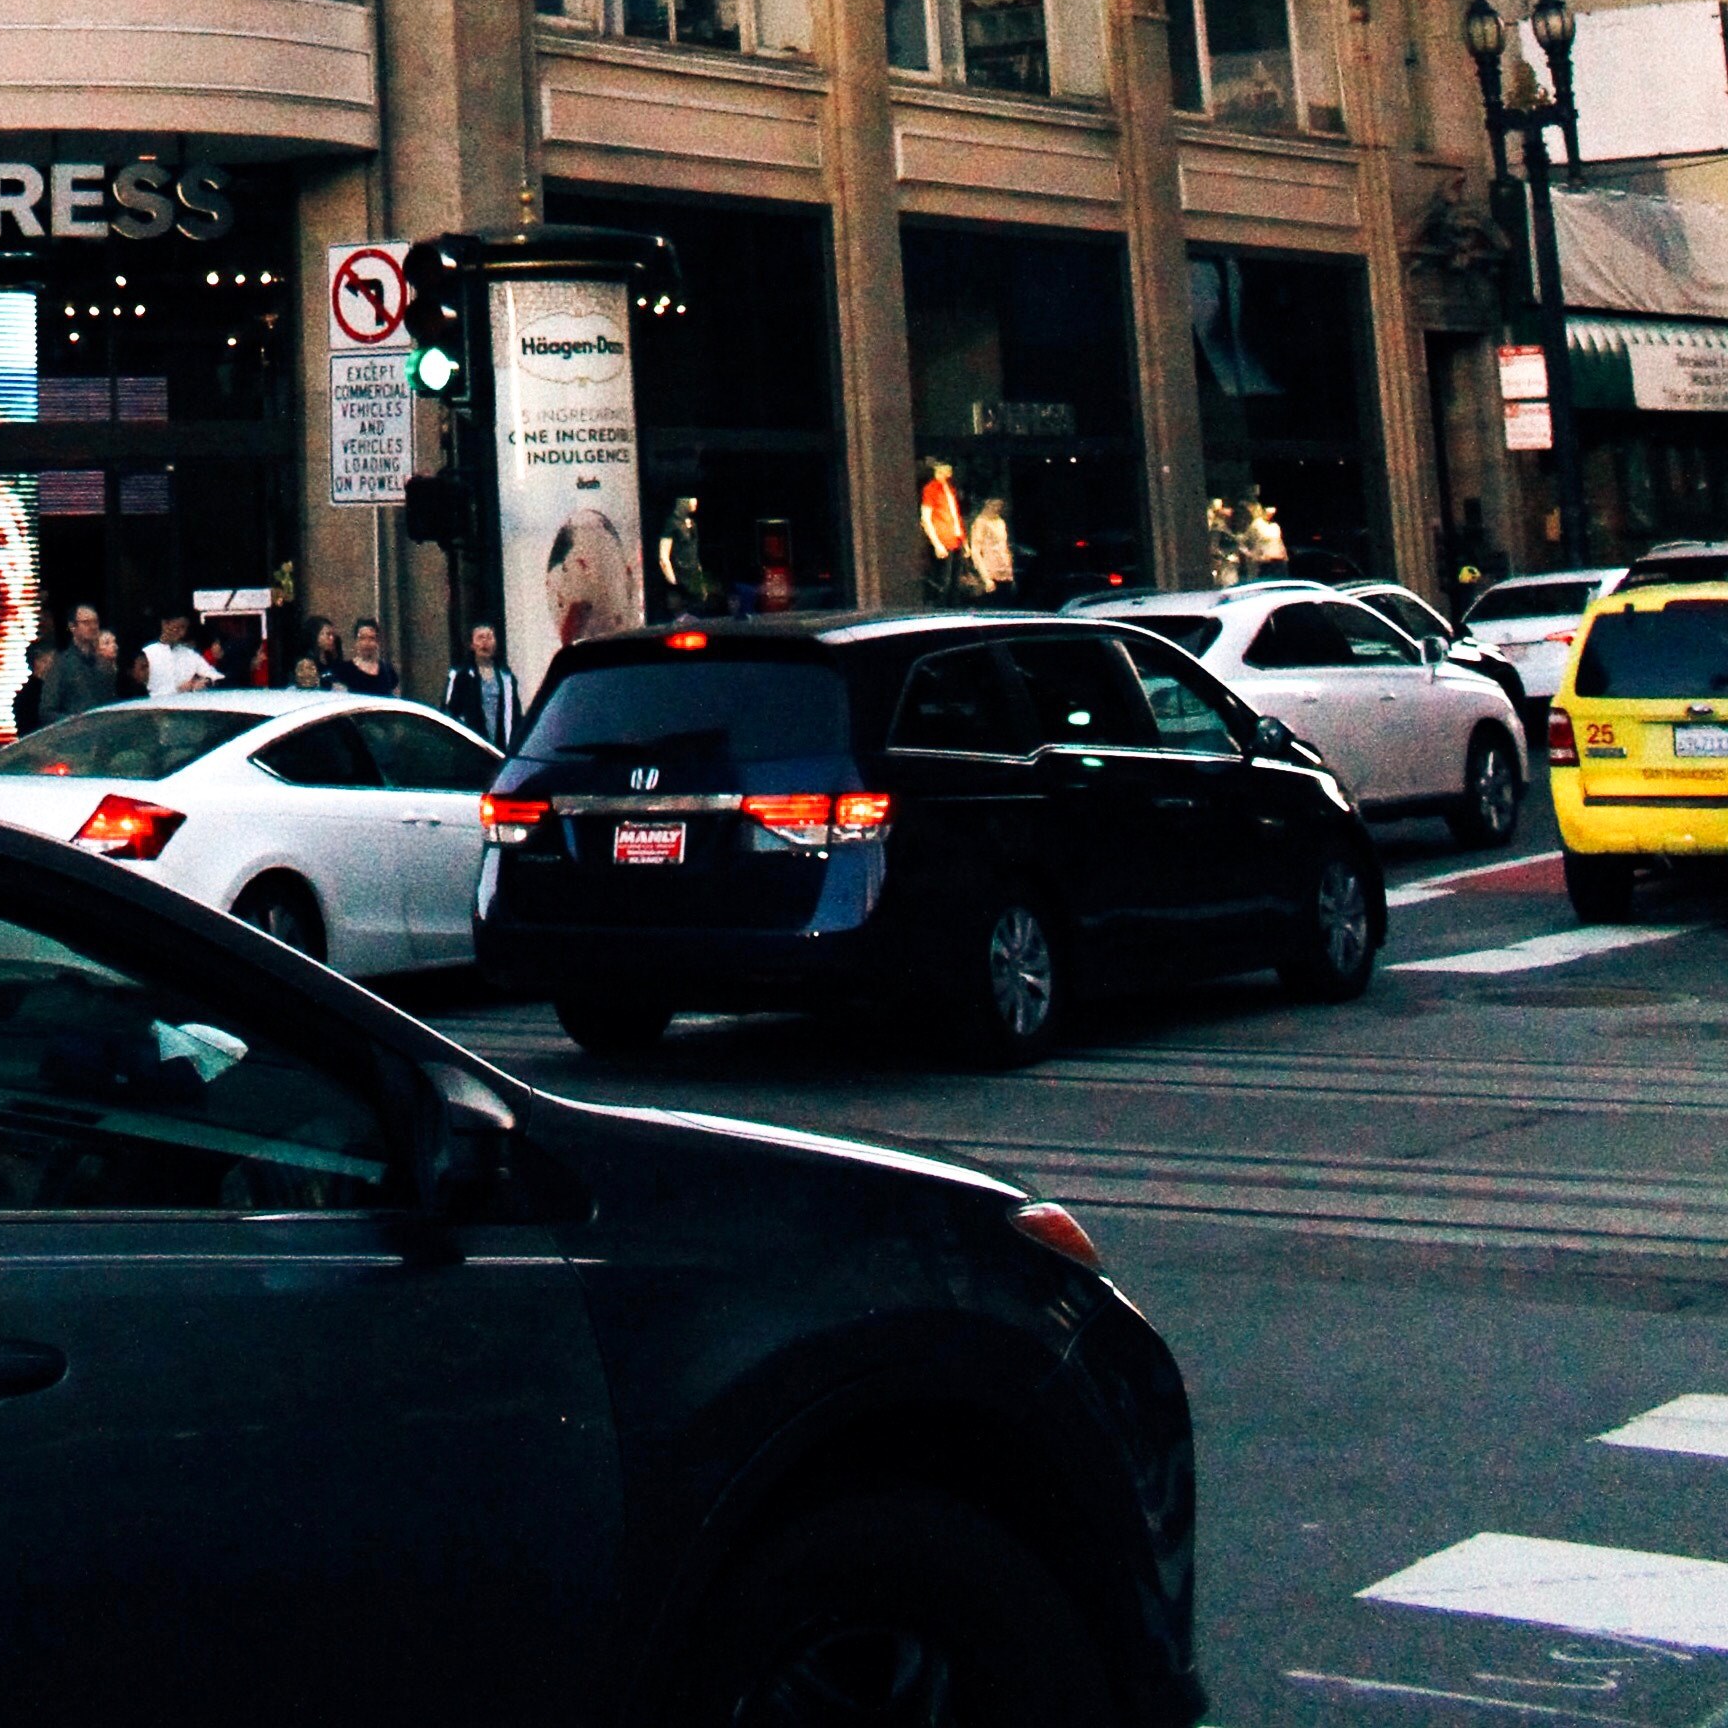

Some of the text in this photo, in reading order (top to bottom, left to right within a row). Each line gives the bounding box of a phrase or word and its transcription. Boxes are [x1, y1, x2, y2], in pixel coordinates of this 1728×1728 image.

[347, 364, 395, 382] EXCEPT
[334, 383, 408, 400] COMMERCIAL
[341, 401, 404, 419] VEHICLES
[359, 420, 385, 437] AND
[341, 438, 403, 455] VEHICLES
[527, 447, 631, 465] INDULGENCE
[344, 456, 401, 474] LOADING
[335, 475, 404, 492] ON POWEL
[1586, 723, 1615, 745] 25
[618, 829, 681, 844] MANLY
